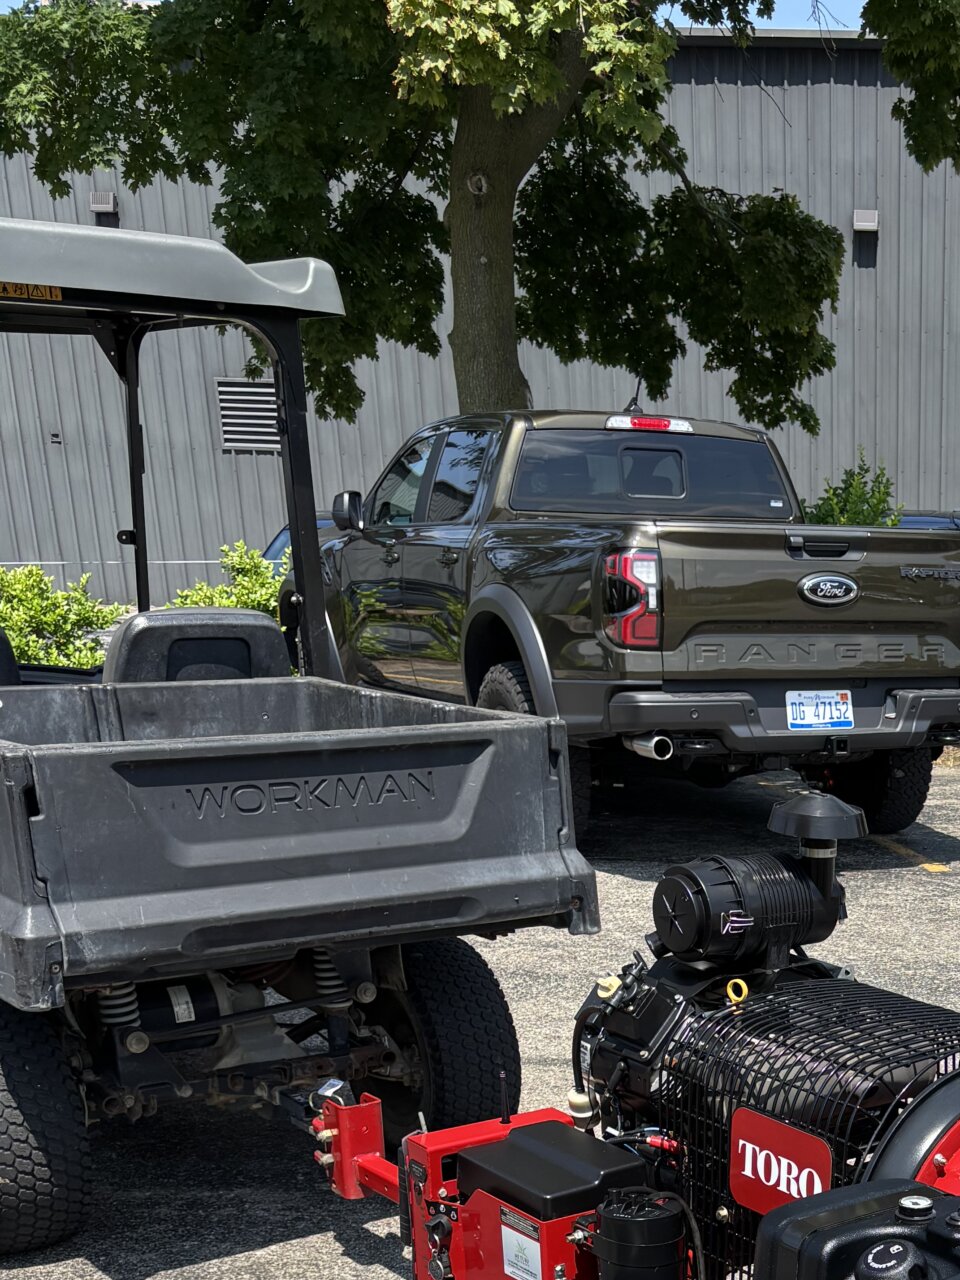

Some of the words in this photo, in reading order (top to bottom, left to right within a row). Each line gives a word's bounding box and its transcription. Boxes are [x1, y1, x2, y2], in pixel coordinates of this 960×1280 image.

[817, 581, 846, 597] Ford
[694, 643, 945, 663] RANGER
[790, 701, 805, 720] DG
[814, 701, 849, 720] 47152
[185, 771, 434, 820] WORKMAN
[738, 1139, 822, 1198] TORO
